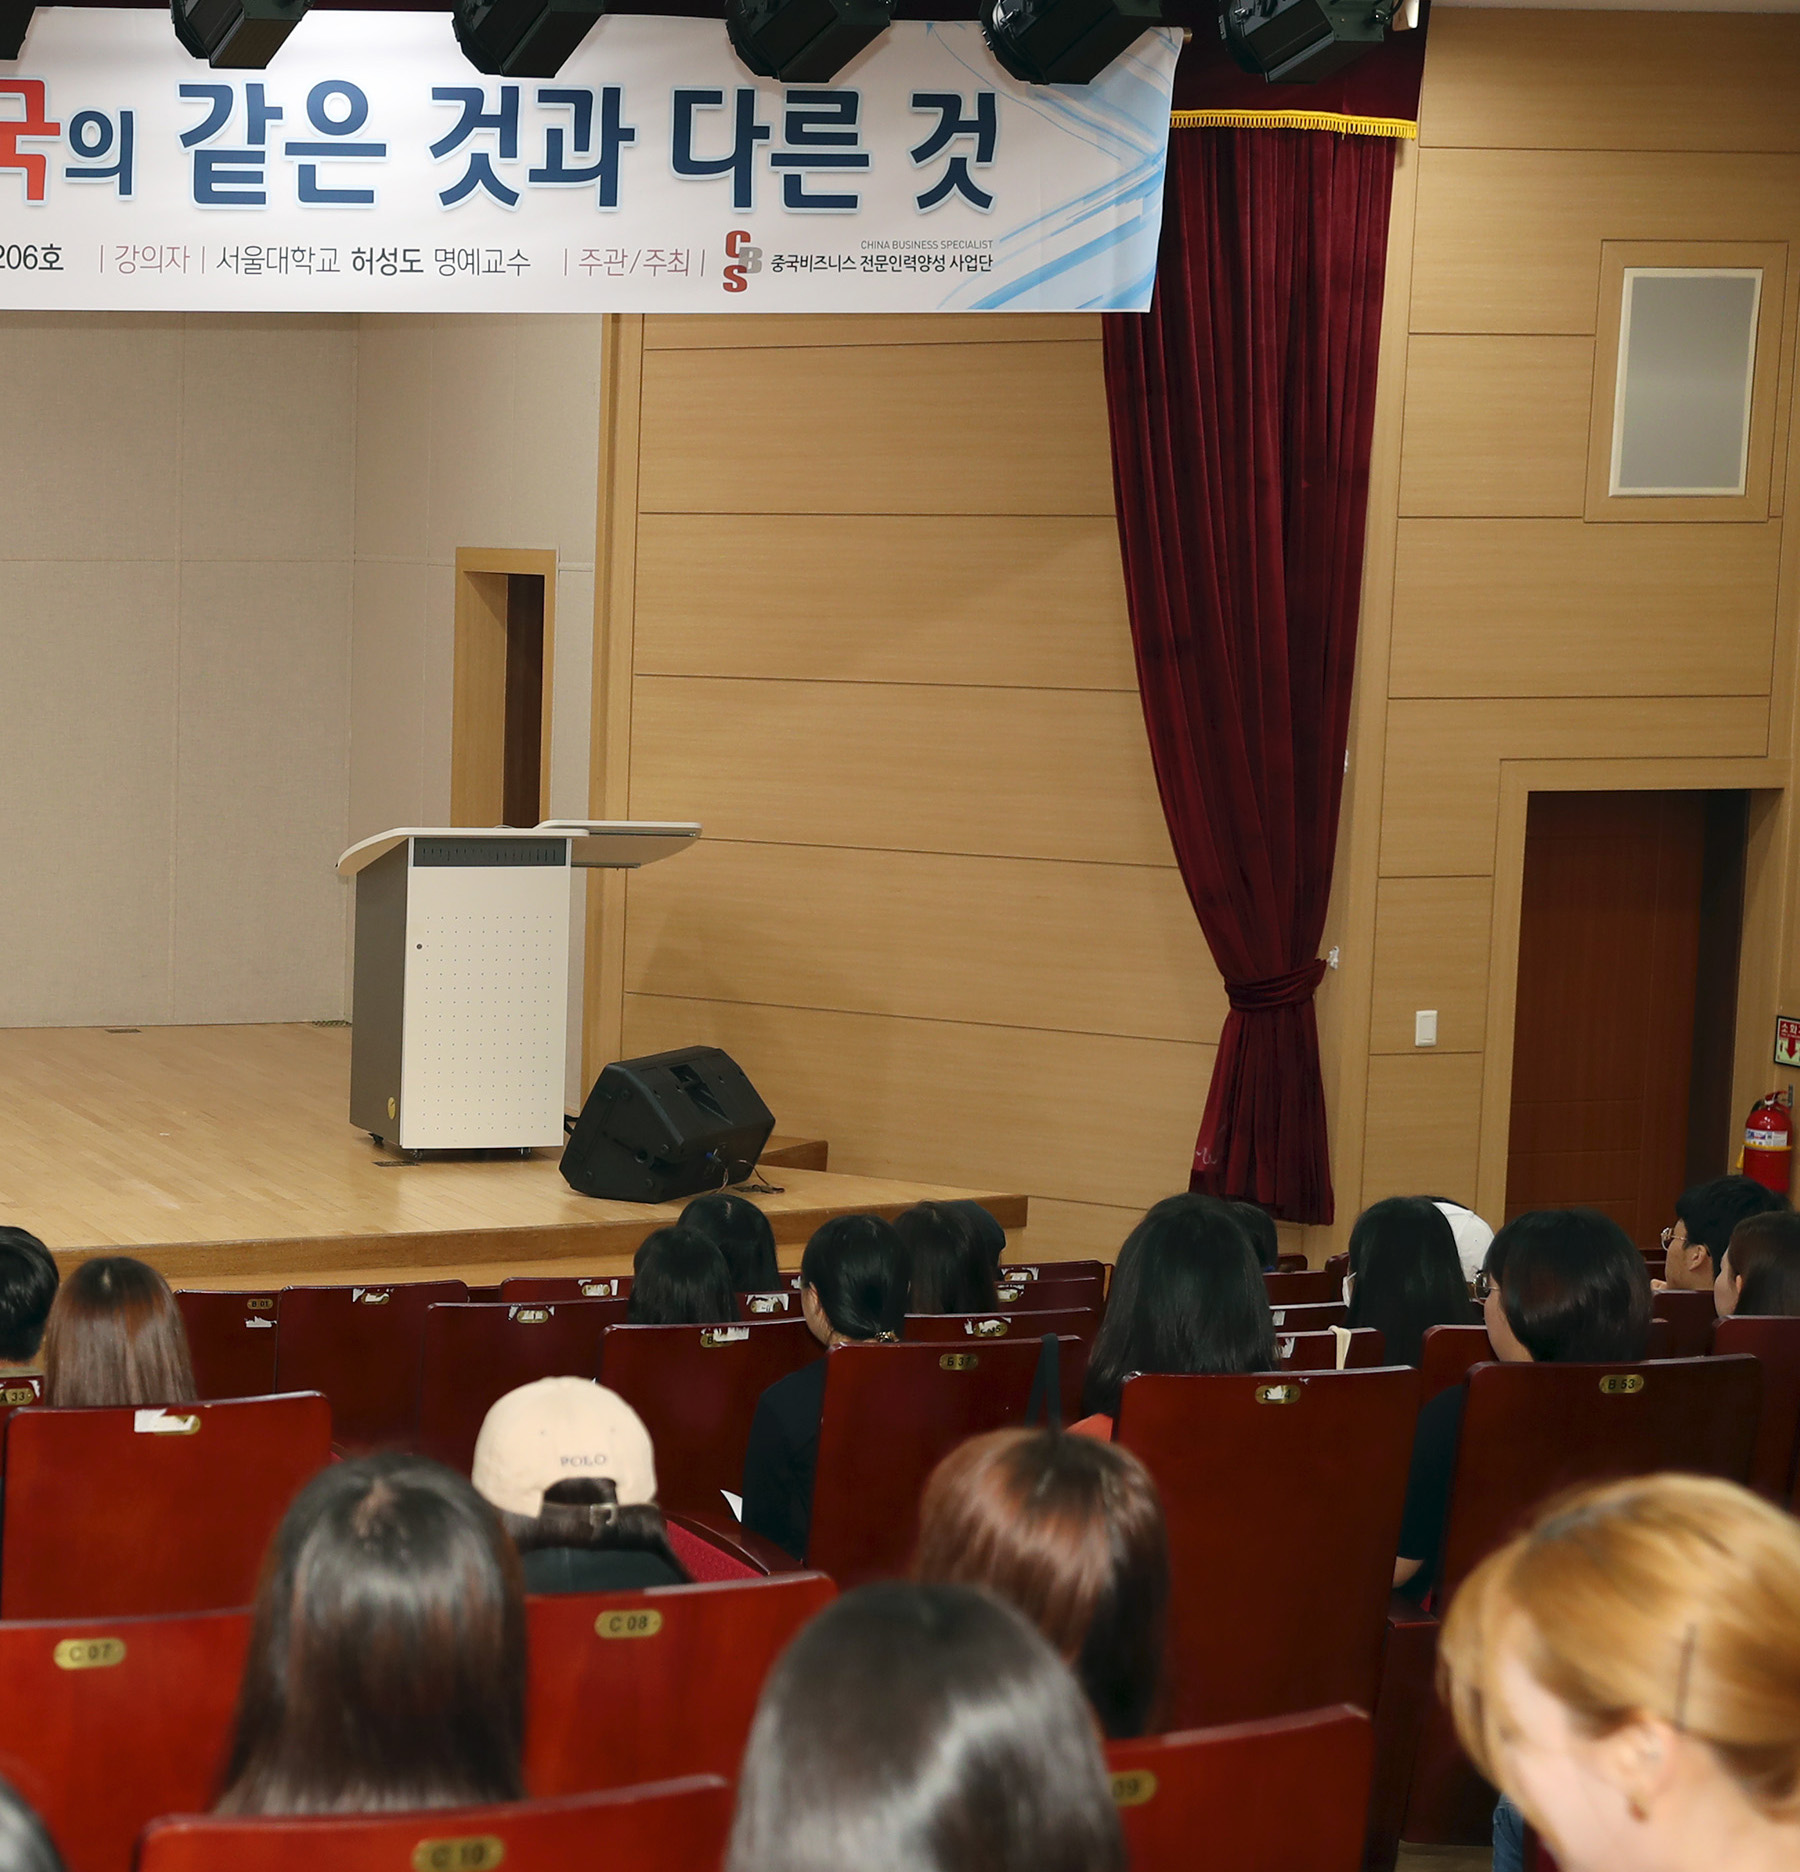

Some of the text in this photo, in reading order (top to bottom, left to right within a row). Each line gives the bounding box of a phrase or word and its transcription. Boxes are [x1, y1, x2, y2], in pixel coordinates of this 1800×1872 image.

[178, 80, 387, 205] 같은
[429, 86, 636, 207] 것과
[671, 88, 870, 209] 다른
[909, 91, 996, 210] 것
[861, 240, 993, 249] CHINA BUSINESS SPECIALIST
[115, 245, 190, 274] 강의자
[217, 246, 530, 276] 서울대학교 허성도 명예교수
[579, 249, 689, 277] 주관/주최
[771, 254, 993, 272] 중국비즈니스 전문인력양성 사업단
[1608, 1378, 1636, 1390] B 53
[12, 1391, 27, 1402] 33
[560, 1454, 607, 1467] POLO
[610, 1615, 648, 1632] C 08
[69, 1646, 81, 1661] C
